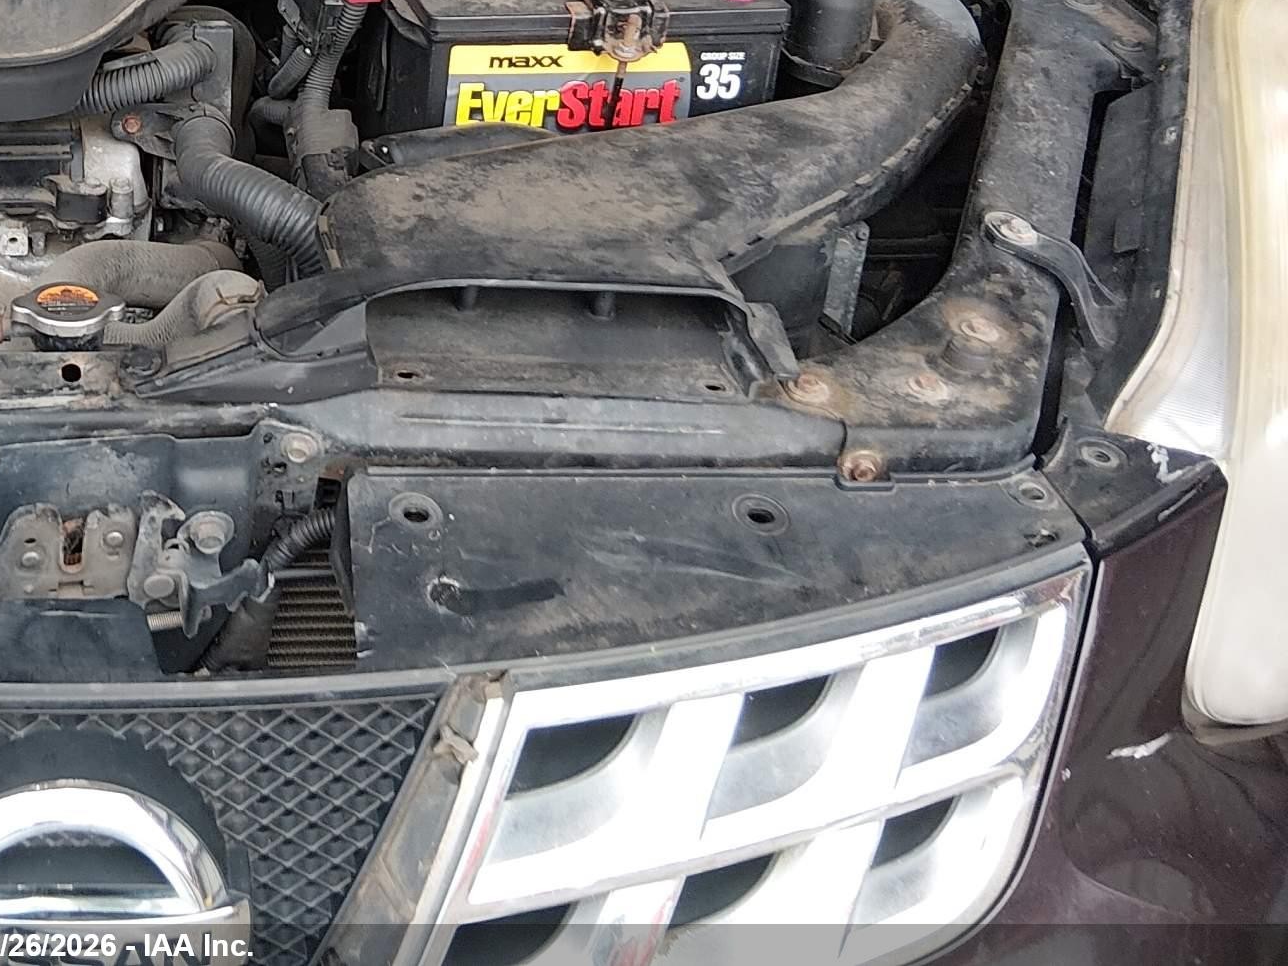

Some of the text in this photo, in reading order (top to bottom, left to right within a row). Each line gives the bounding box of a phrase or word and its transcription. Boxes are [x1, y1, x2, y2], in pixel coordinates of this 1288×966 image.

[488, 55, 564, 69] maxx
[701, 52, 746, 61] GROUP SIZE
[696, 63, 742, 100] 35
[456, 79, 681, 131] EverStart
